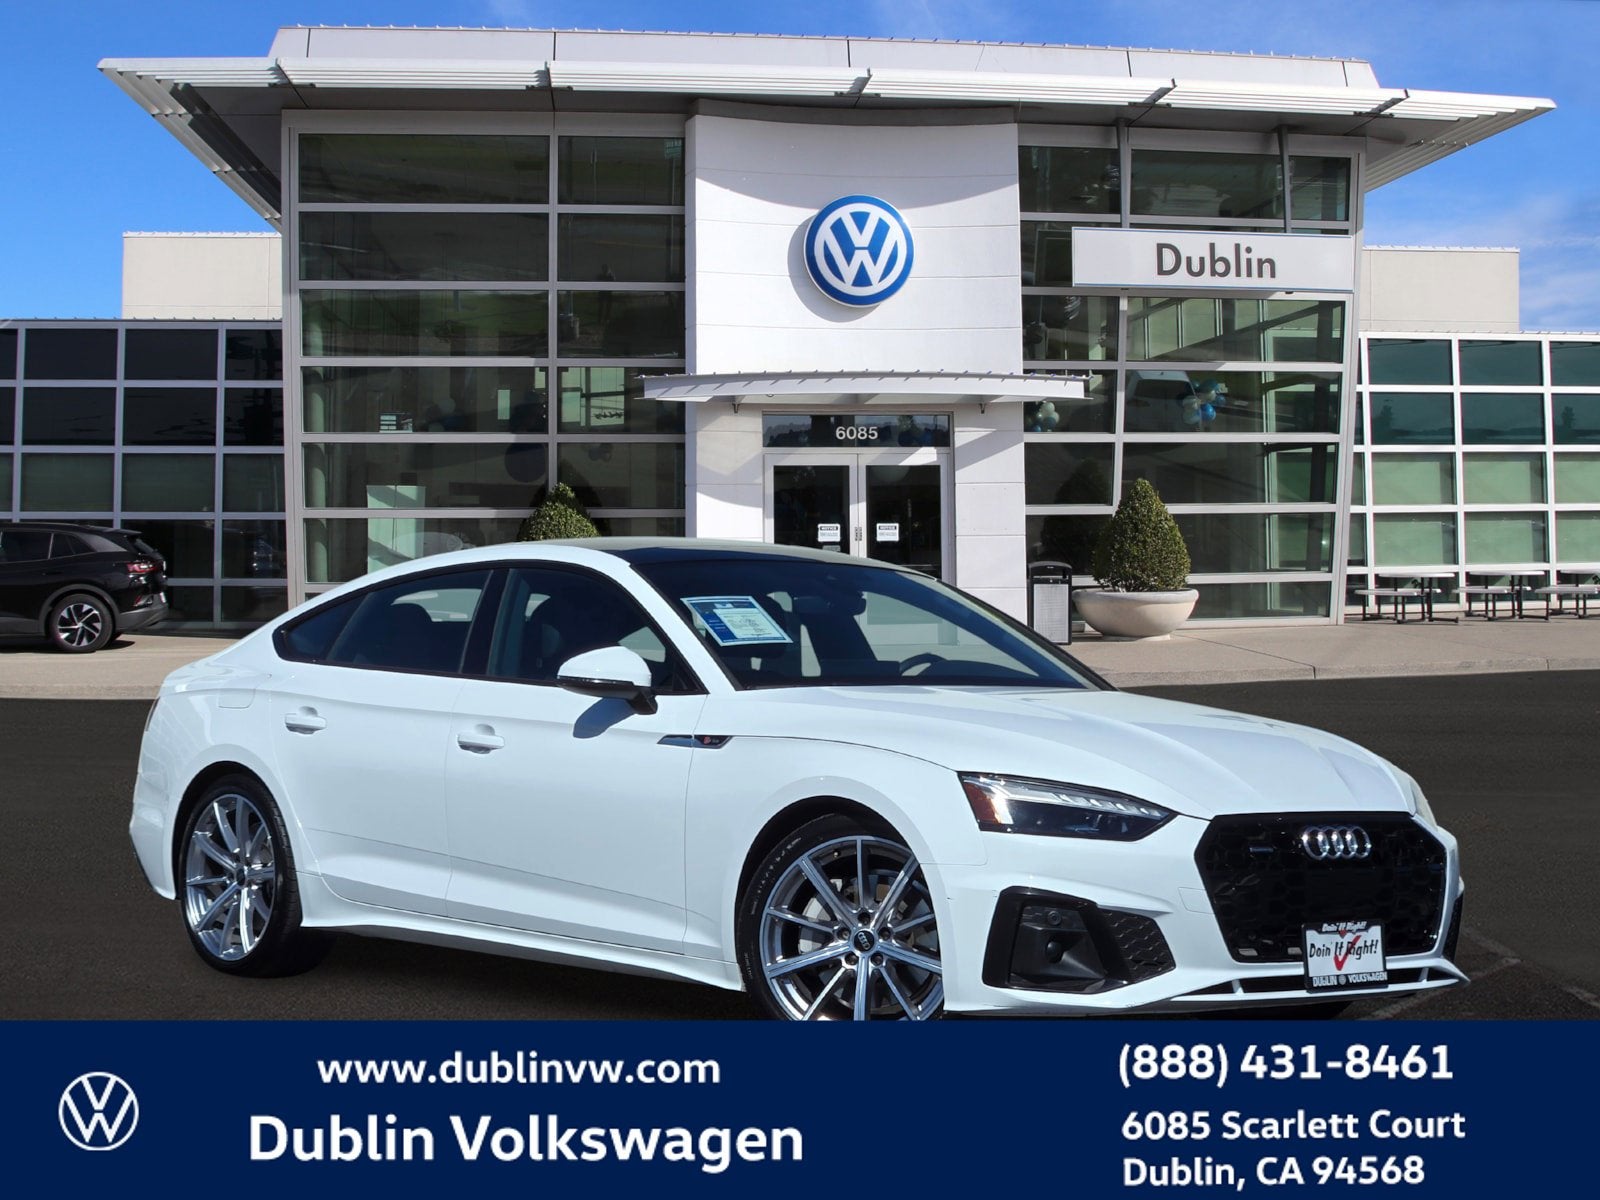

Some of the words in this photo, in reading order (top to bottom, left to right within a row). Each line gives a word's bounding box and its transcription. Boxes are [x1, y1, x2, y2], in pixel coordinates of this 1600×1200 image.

[1156, 242, 1277, 279] Dublin
[835, 426, 879, 440] 6085
[1334, 941, 1344, 956] It
[1312, 976, 1338, 987] DUBLIN
[1347, 971, 1388, 983] VOLKSWAGEN
